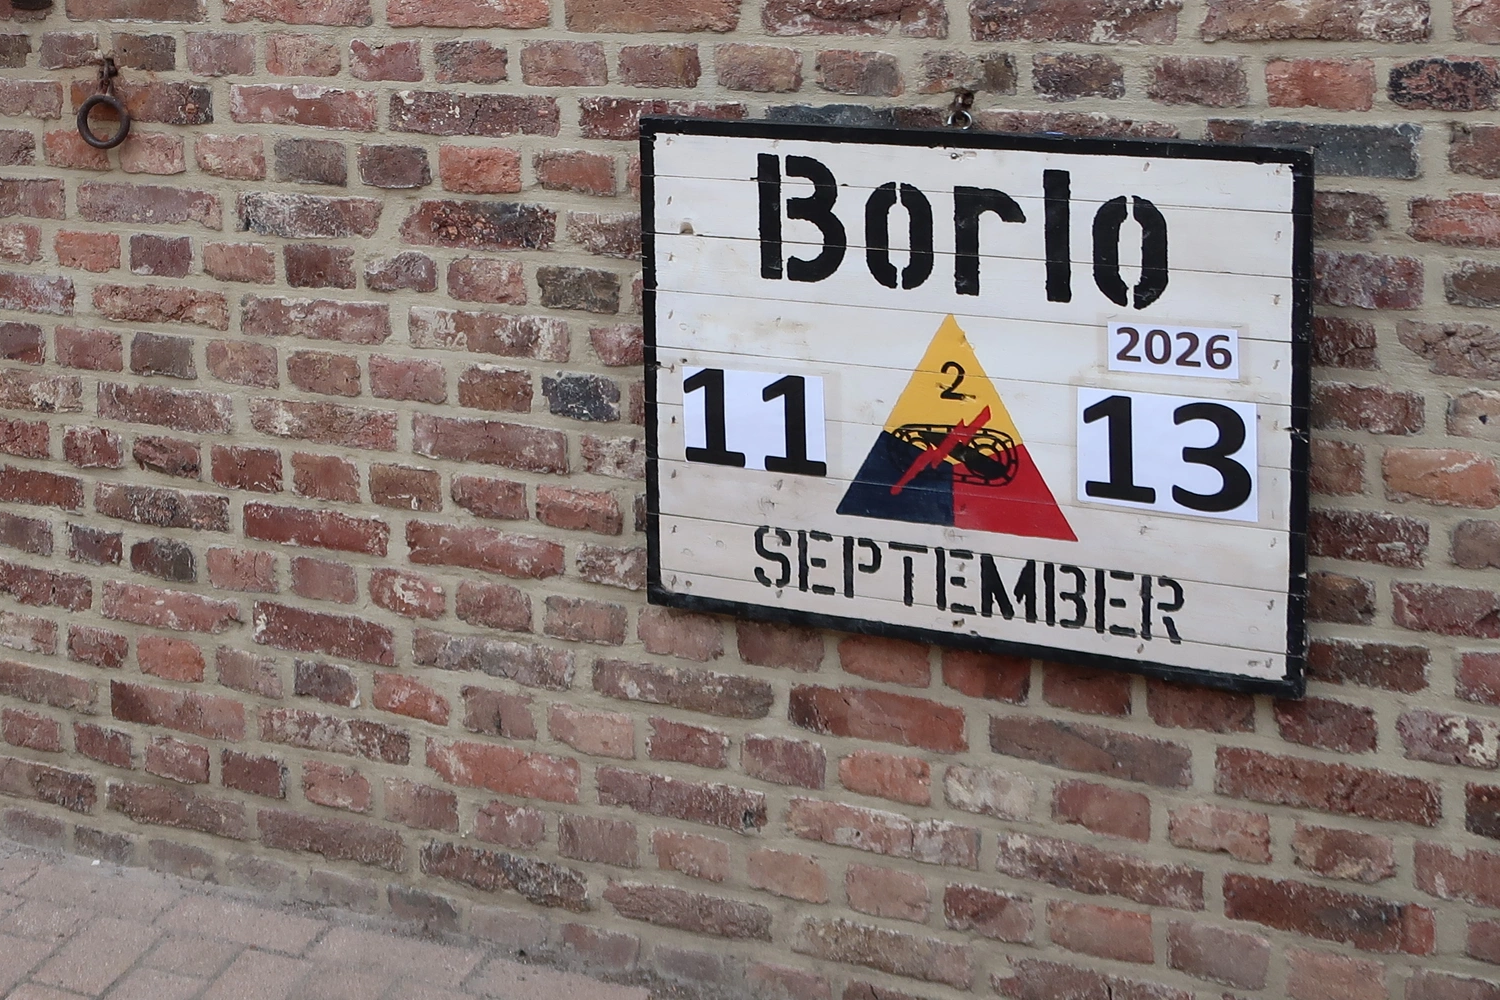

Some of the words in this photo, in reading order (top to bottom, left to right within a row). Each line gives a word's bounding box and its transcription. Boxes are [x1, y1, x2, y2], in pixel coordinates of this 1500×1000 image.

[756, 152, 1169, 310] Borlo
[939, 360, 971, 400] 2
[1115, 326, 1233, 370] 2026
[682, 367, 827, 477] 11
[1082, 394, 1254, 513] 13
[754, 525, 1186, 645] SEPTEMBER
